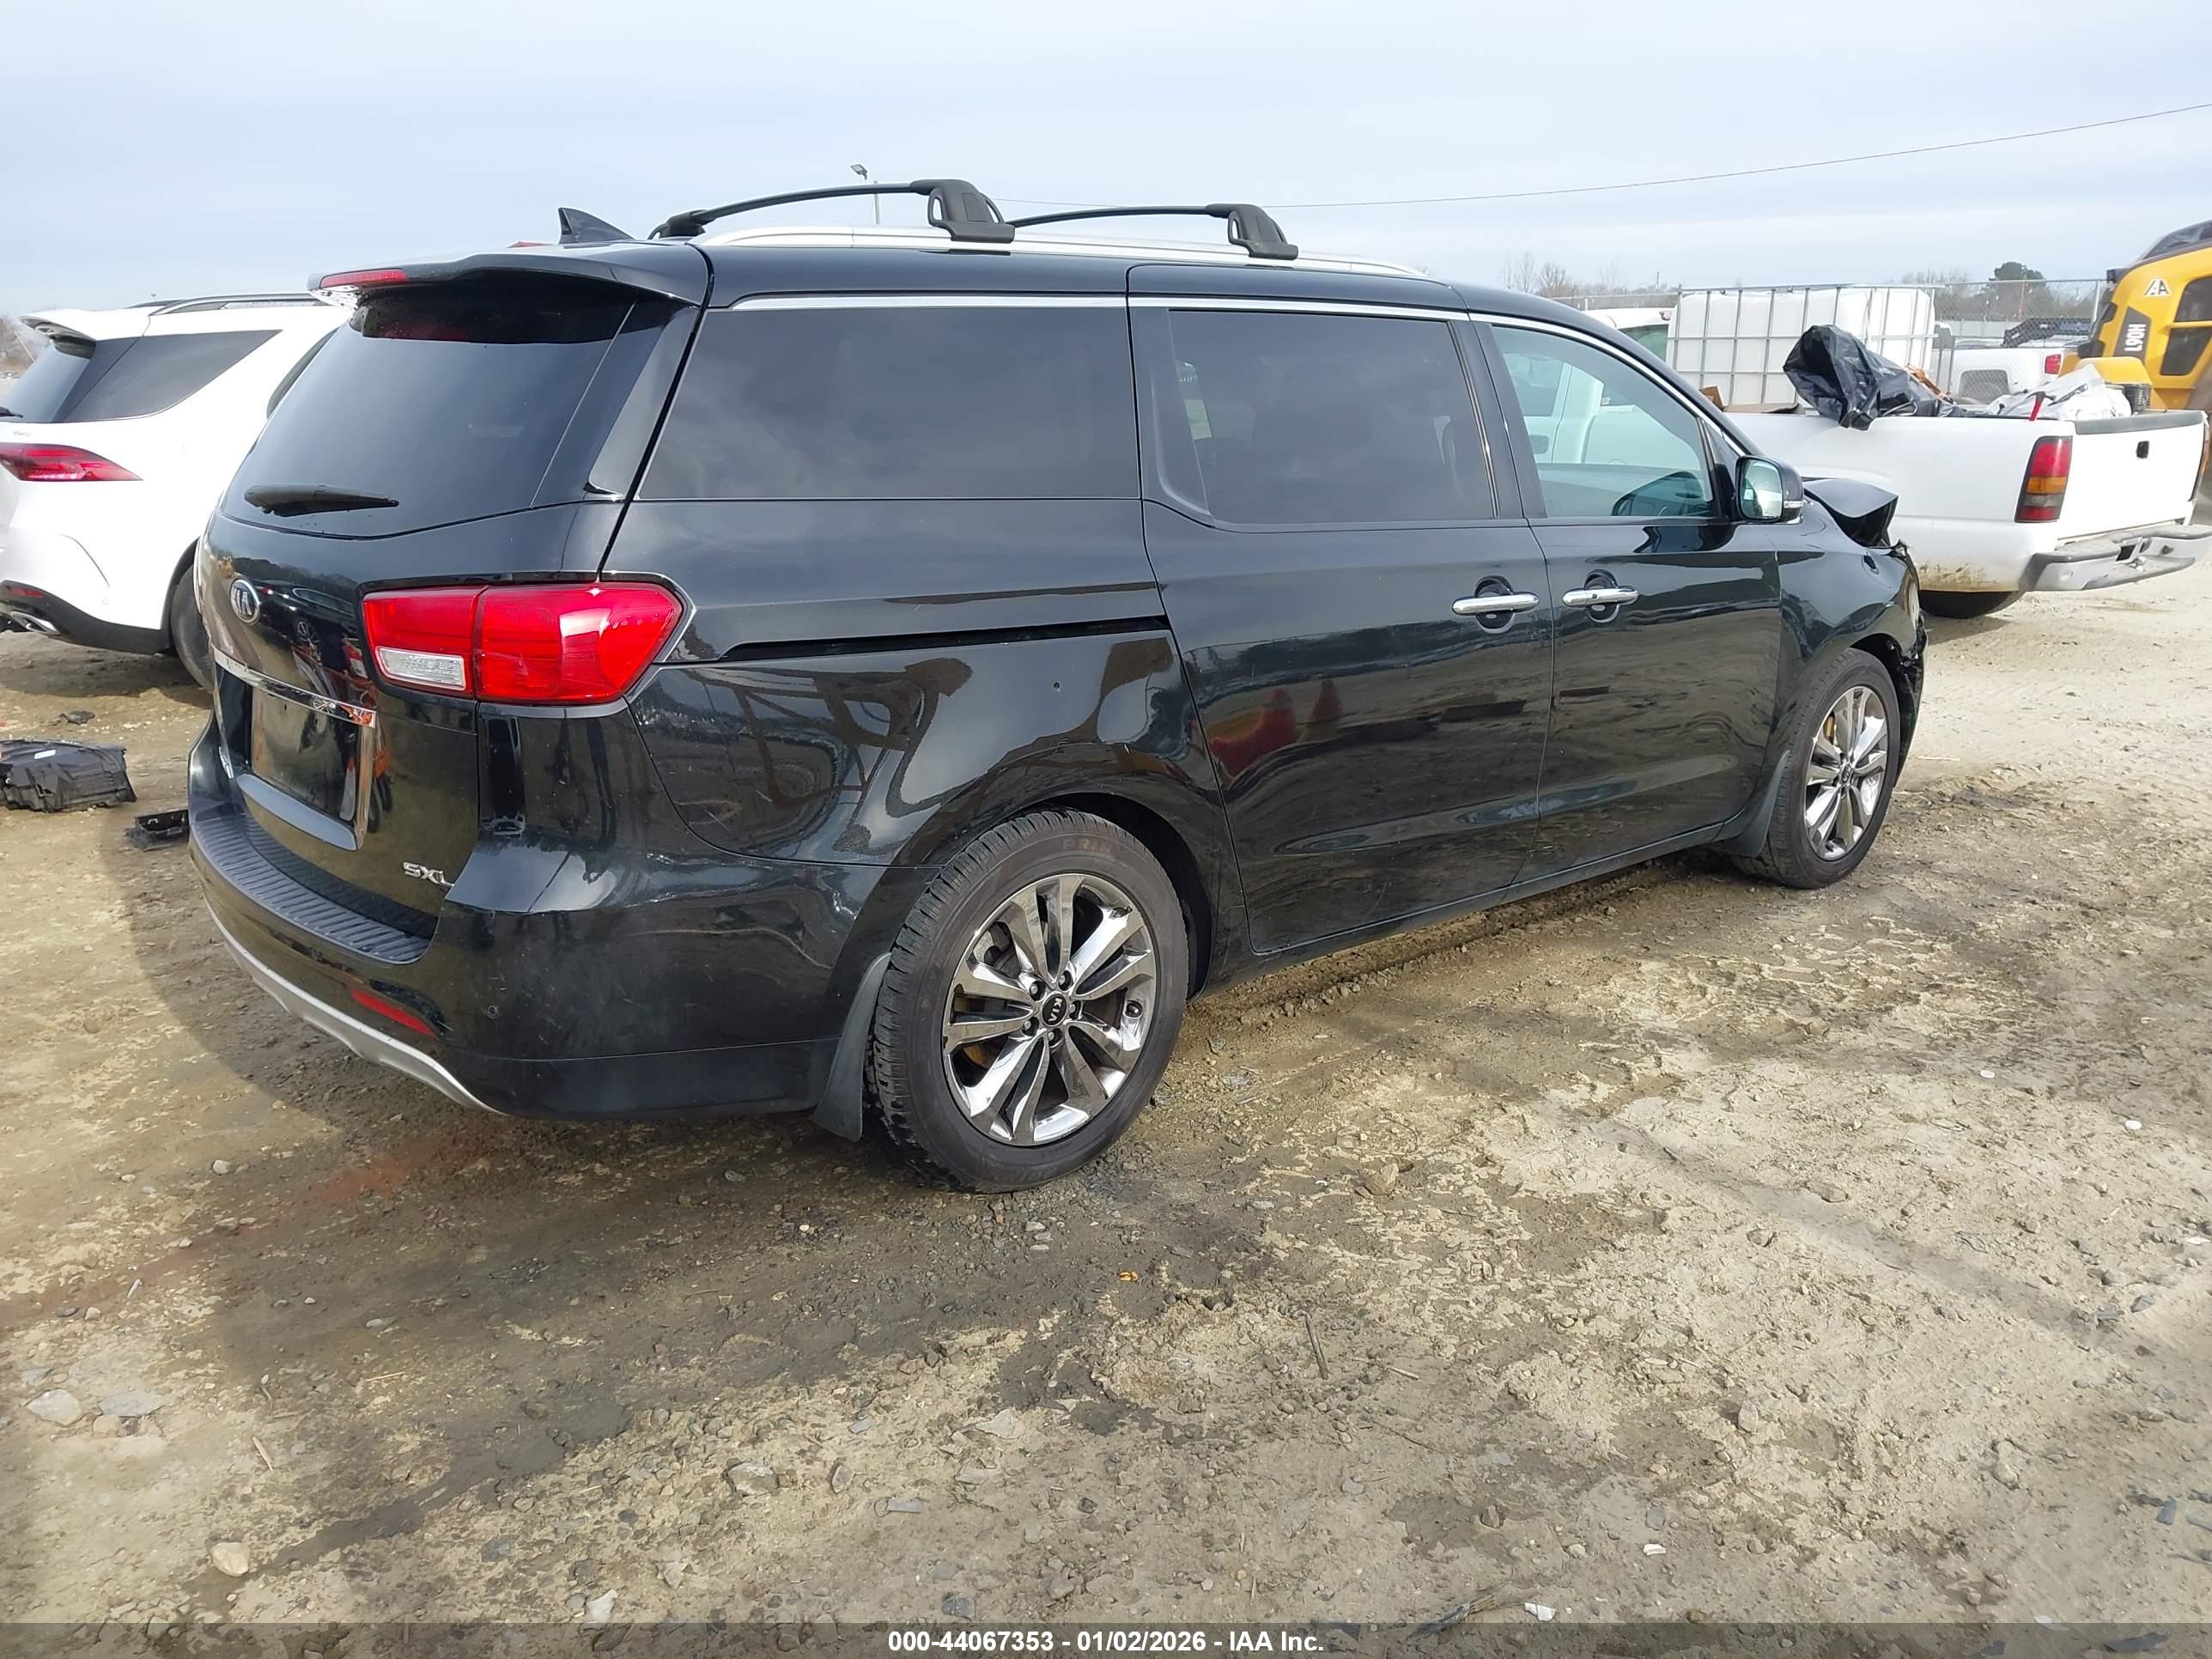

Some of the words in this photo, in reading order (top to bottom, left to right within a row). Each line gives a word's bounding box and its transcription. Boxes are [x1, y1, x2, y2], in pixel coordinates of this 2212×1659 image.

[2124, 323, 2147, 351] L90H
[403, 861, 454, 886] SXL
[1048, 997, 1063, 1022] KIA
